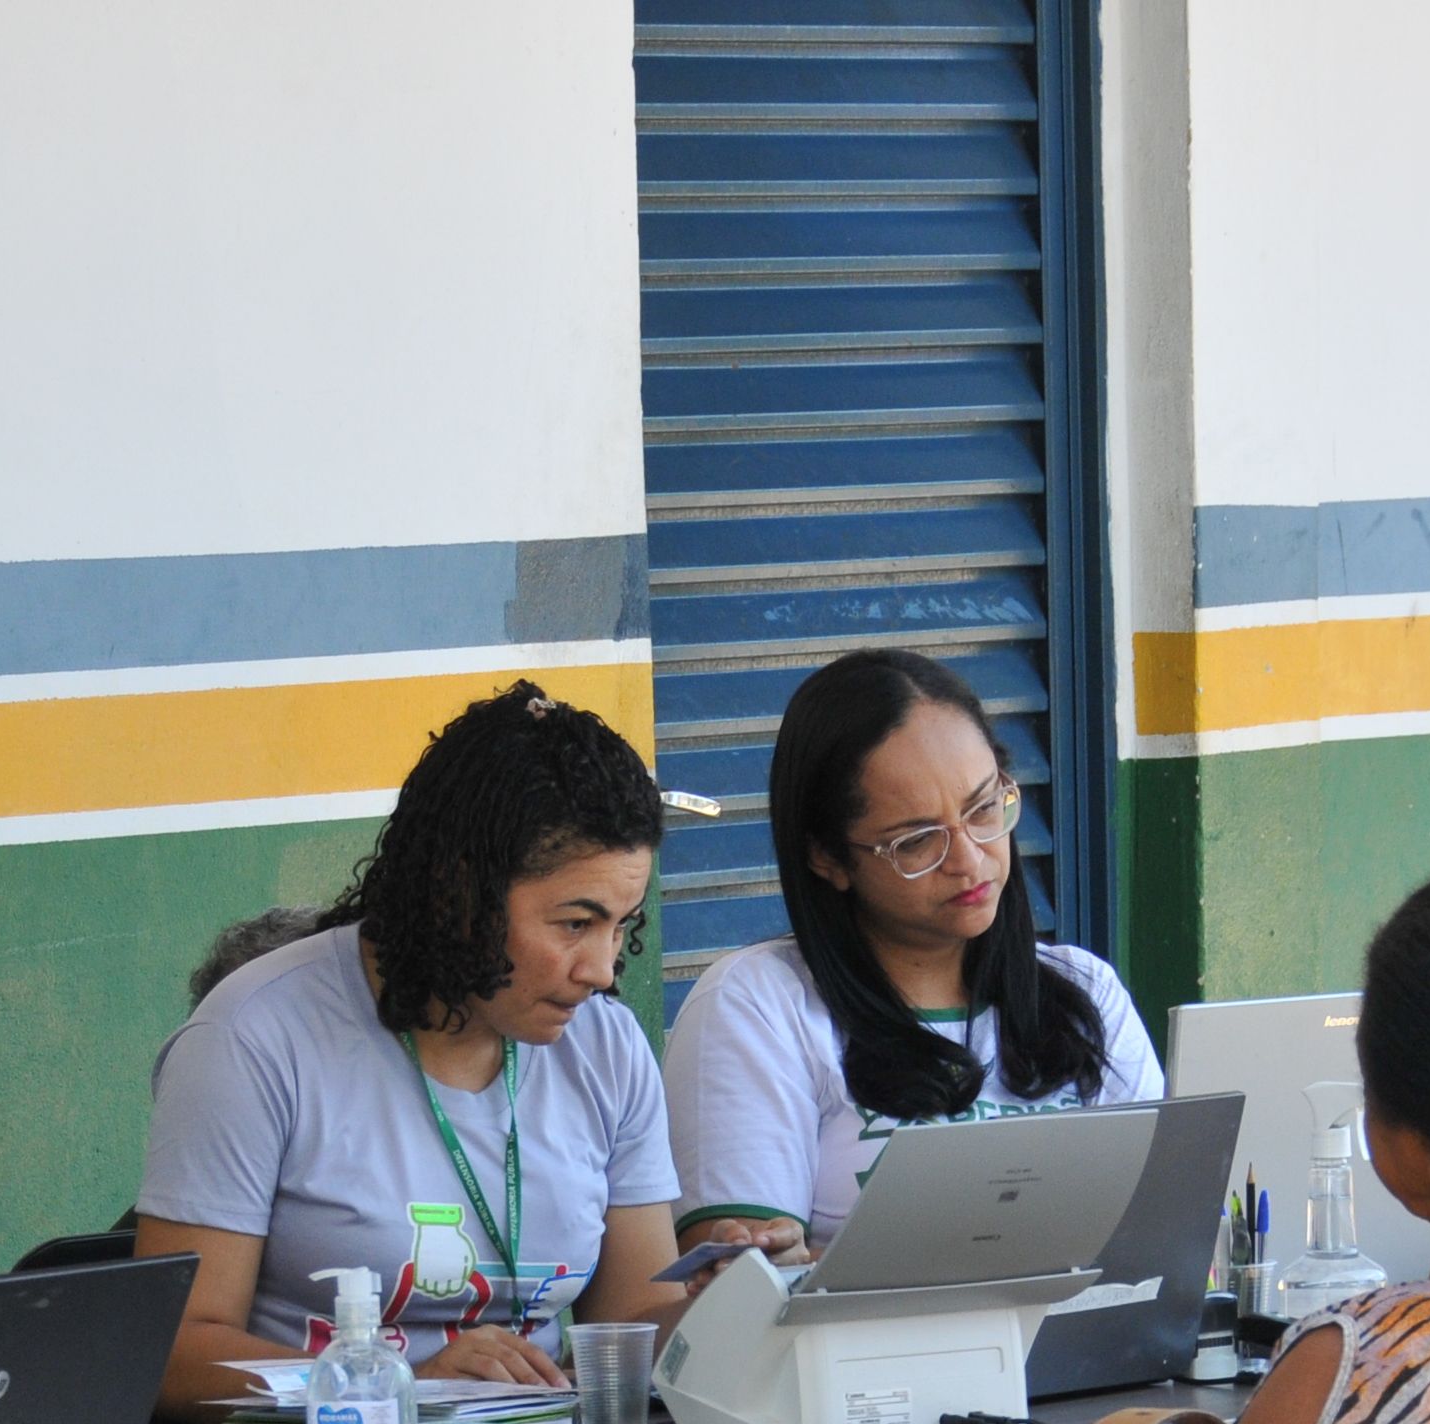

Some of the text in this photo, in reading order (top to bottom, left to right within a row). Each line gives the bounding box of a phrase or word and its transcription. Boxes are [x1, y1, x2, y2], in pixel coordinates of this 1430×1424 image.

[453, 1149, 480, 1201] DEFENSORIA
[475, 1200, 496, 1237] PÚBLICA
[507, 1149, 517, 1185] PÚBLICA
[508, 1186, 518, 1240] DEFENSORIA
